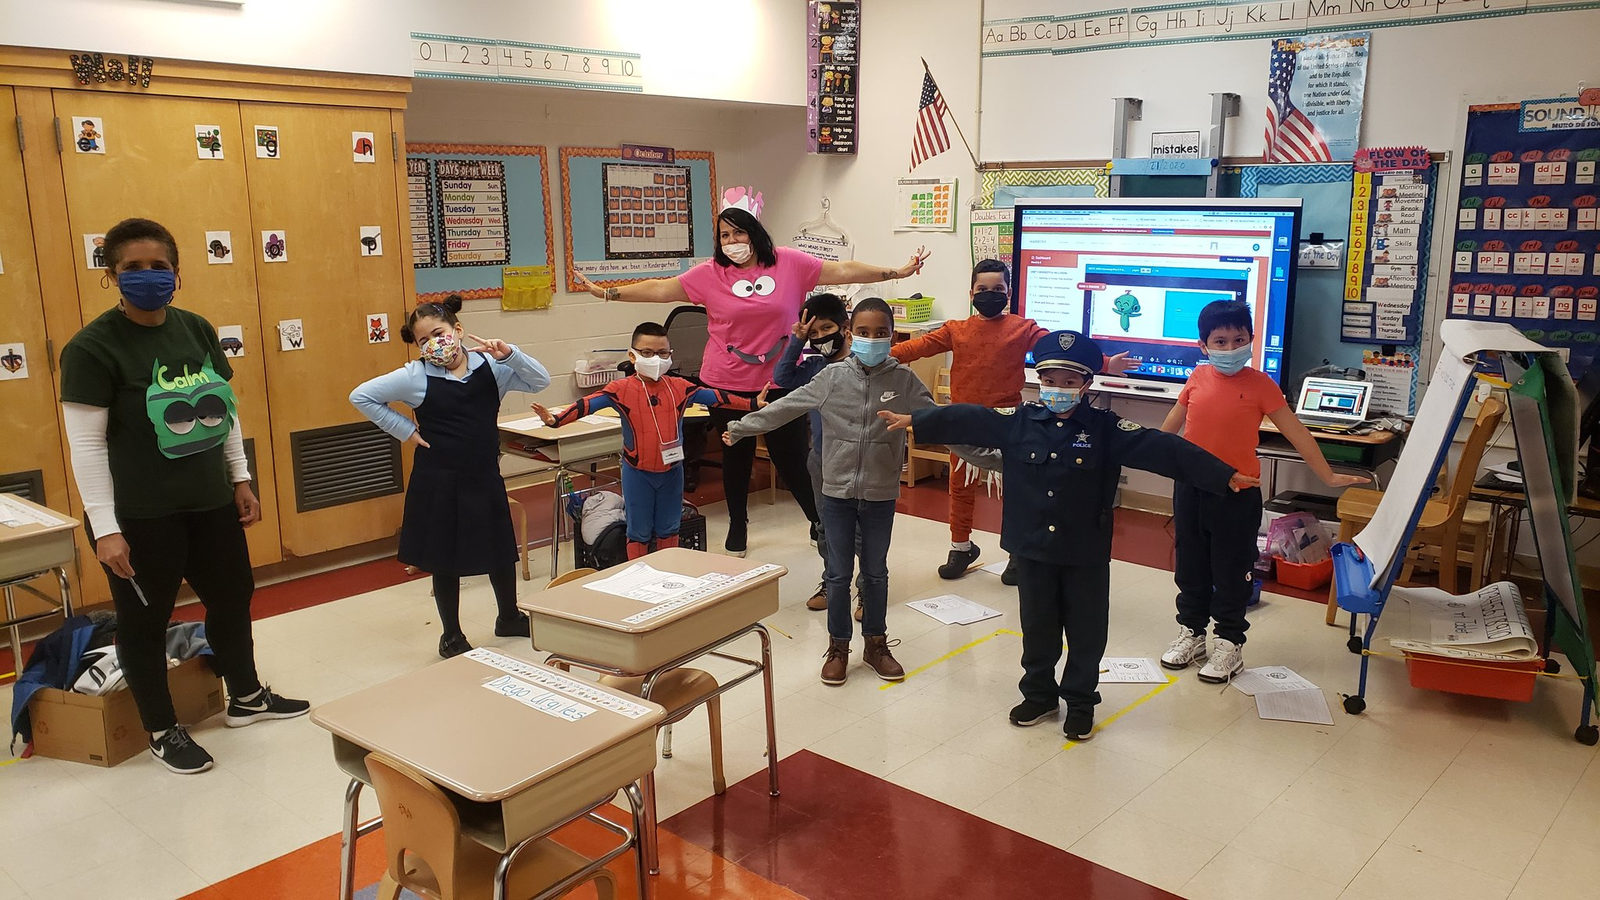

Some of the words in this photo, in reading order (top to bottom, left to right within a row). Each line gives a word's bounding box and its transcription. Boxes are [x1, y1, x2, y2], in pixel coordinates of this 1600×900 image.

[984, 28, 1003, 44] Aa
[1009, 24, 1027, 42] Bb
[1034, 23, 1051, 40] Cc
[1056, 23, 1076, 40] Dd
[1084, 20, 1100, 37] Ee
[1108, 17, 1124, 34] Ff
[1136, 14, 1157, 38] Gg
[1166, 12, 1186, 29] Hh
[1196, 10, 1206, 26] Ii
[1217, 8, 1234, 32] Jj
[1246, 6, 1266, 22] Kk
[1279, 3, 1294, 20] Ll
[1308, 0, 1341, 16] Mm
[1350, 0, 1374, 12] Nn
[812, 39, 817, 48] 2
[420, 42, 432, 60] 0
[460, 46, 470, 64] 2
[481, 48, 490, 65] 3
[503, 48, 512, 66] 4
[524, 51, 533, 68] 5
[544, 53, 552, 69] 6
[562, 54, 569, 71] 7
[582, 56, 590, 73] 8
[602, 58, 610, 74] 9
[621, 60, 633, 76] 10
[70, 54, 153, 88] Wall
[812, 69, 817, 78] 3
[811, 98, 816, 108] 4
[1526, 108, 1585, 122] SOUND
[811, 129, 816, 138] 5
[266, 137, 278, 157] g
[1153, 144, 1198, 154] mistakes
[1370, 150, 1404, 159] FLOW
[410, 161, 427, 173] YEAR
[1373, 160, 1397, 168] THE
[440, 164, 459, 176] DAYS
[480, 164, 500, 176] WEEK
[444, 181, 472, 190] Sunday
[1359, 187, 1366, 197] 2
[444, 193, 475, 202] Monday
[445, 205, 475, 214] Tuesday
[1358, 200, 1364, 210] 3
[446, 217, 483, 225] Wednesday
[975, 212, 996, 220] Doubles
[1356, 213, 1363, 223] 4
[1489, 212, 1493, 220] j
[447, 229, 481, 237] Thursday
[1355, 226, 1362, 236] 5
[448, 241, 470, 249] Friday
[1354, 238, 1362, 248] 6
[1353, 251, 1360, 261] 7
[1352, 264, 1359, 273] 8
[1351, 276, 1358, 286] 9
[1347, 288, 1358, 298] 10
[289, 338, 304, 349] w
[158, 364, 210, 390] Calm
[489, 676, 531, 697] Diego
